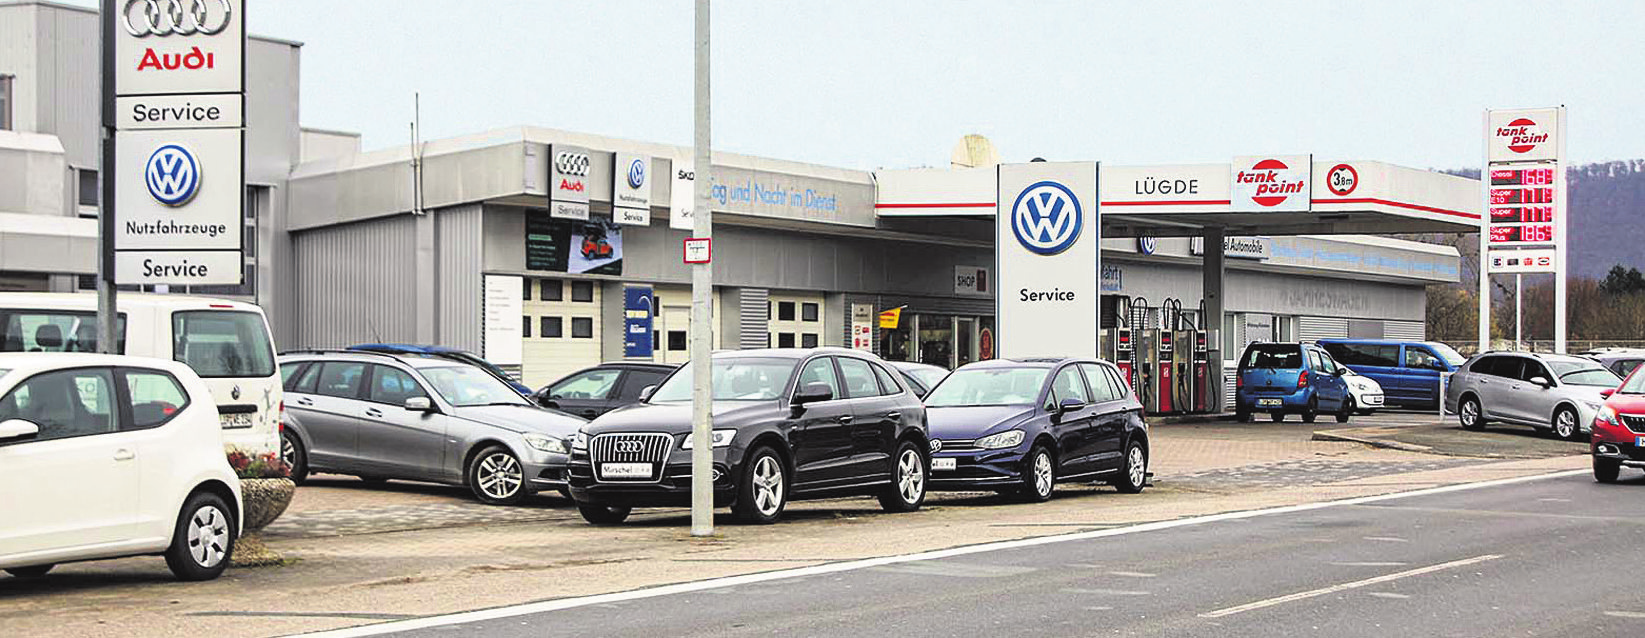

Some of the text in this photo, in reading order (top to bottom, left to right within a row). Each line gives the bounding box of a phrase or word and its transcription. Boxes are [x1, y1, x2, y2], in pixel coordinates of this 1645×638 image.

[137, 46, 214, 71] Audi
[133, 102, 220, 122] Service
[1496, 126, 1528, 137] tank
[1511, 133, 1549, 146] point
[1237, 170, 1278, 184] tank
[560, 178, 585, 193] Audi
[711, 180, 727, 206] ag
[731, 179, 751, 203] und
[755, 182, 786, 205] Nacht
[791, 186, 803, 207] im
[1135, 176, 1199, 195] LÜGDE
[1256, 180, 1304, 196] point
[1490, 188, 1512, 197] Super
[558, 204, 585, 217] Service
[624, 211, 644, 223] Service
[1490, 207, 1512, 216] Super
[126, 219, 226, 238] Nutzfahrzeuge
[1490, 226, 1512, 235] Super
[1230, 238, 1263, 254] Automobile
[143, 258, 208, 278] Service
[957, 275, 976, 288] SHOP
[1019, 287, 1075, 302] Service
